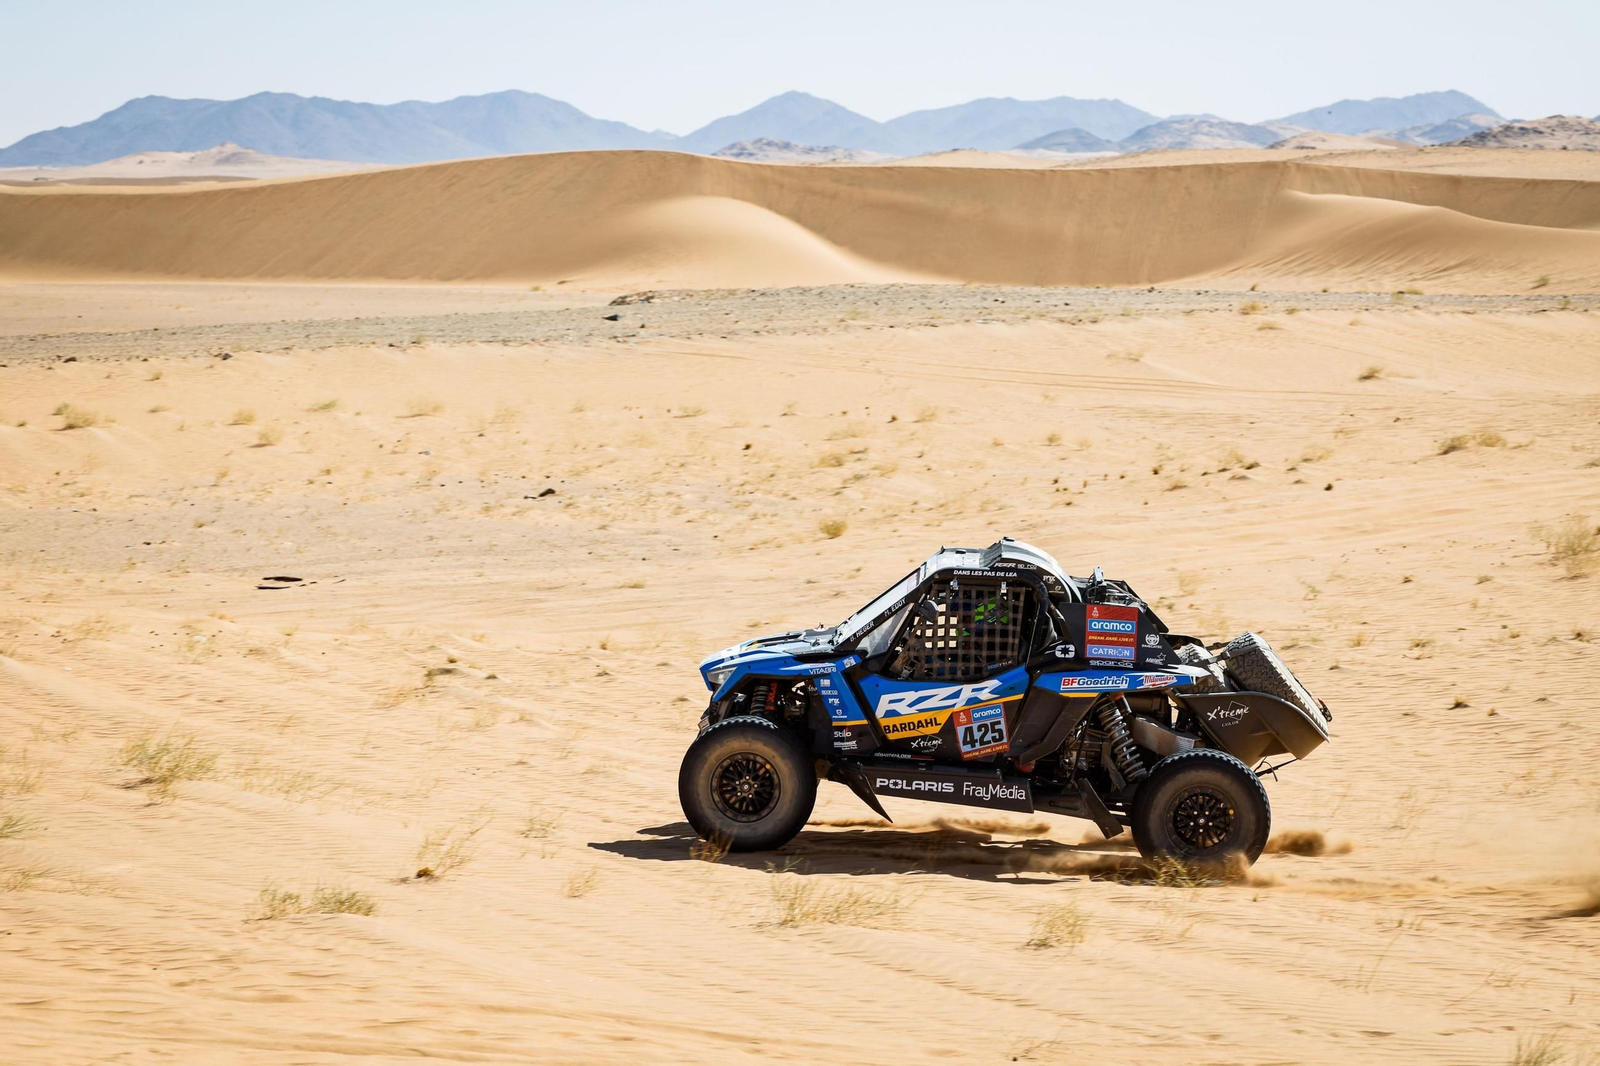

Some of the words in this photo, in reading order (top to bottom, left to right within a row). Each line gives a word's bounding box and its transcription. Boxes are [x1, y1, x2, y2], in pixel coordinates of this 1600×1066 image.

[1091, 621, 1132, 631] aramco
[1092, 647, 1130, 658] CATRION
[1089, 660, 1134, 669] sparco
[1062, 675, 1128, 688] BFGoodrich
[875, 679, 1002, 719] RZR
[973, 707, 1001, 719] aramco
[1206, 705, 1250, 721] X'treme
[883, 717, 942, 735] BARDAHL
[962, 720, 1005, 749] 425
[876, 778, 955, 794] POLARIS
[962, 781, 1026, 801] FrayMédia
